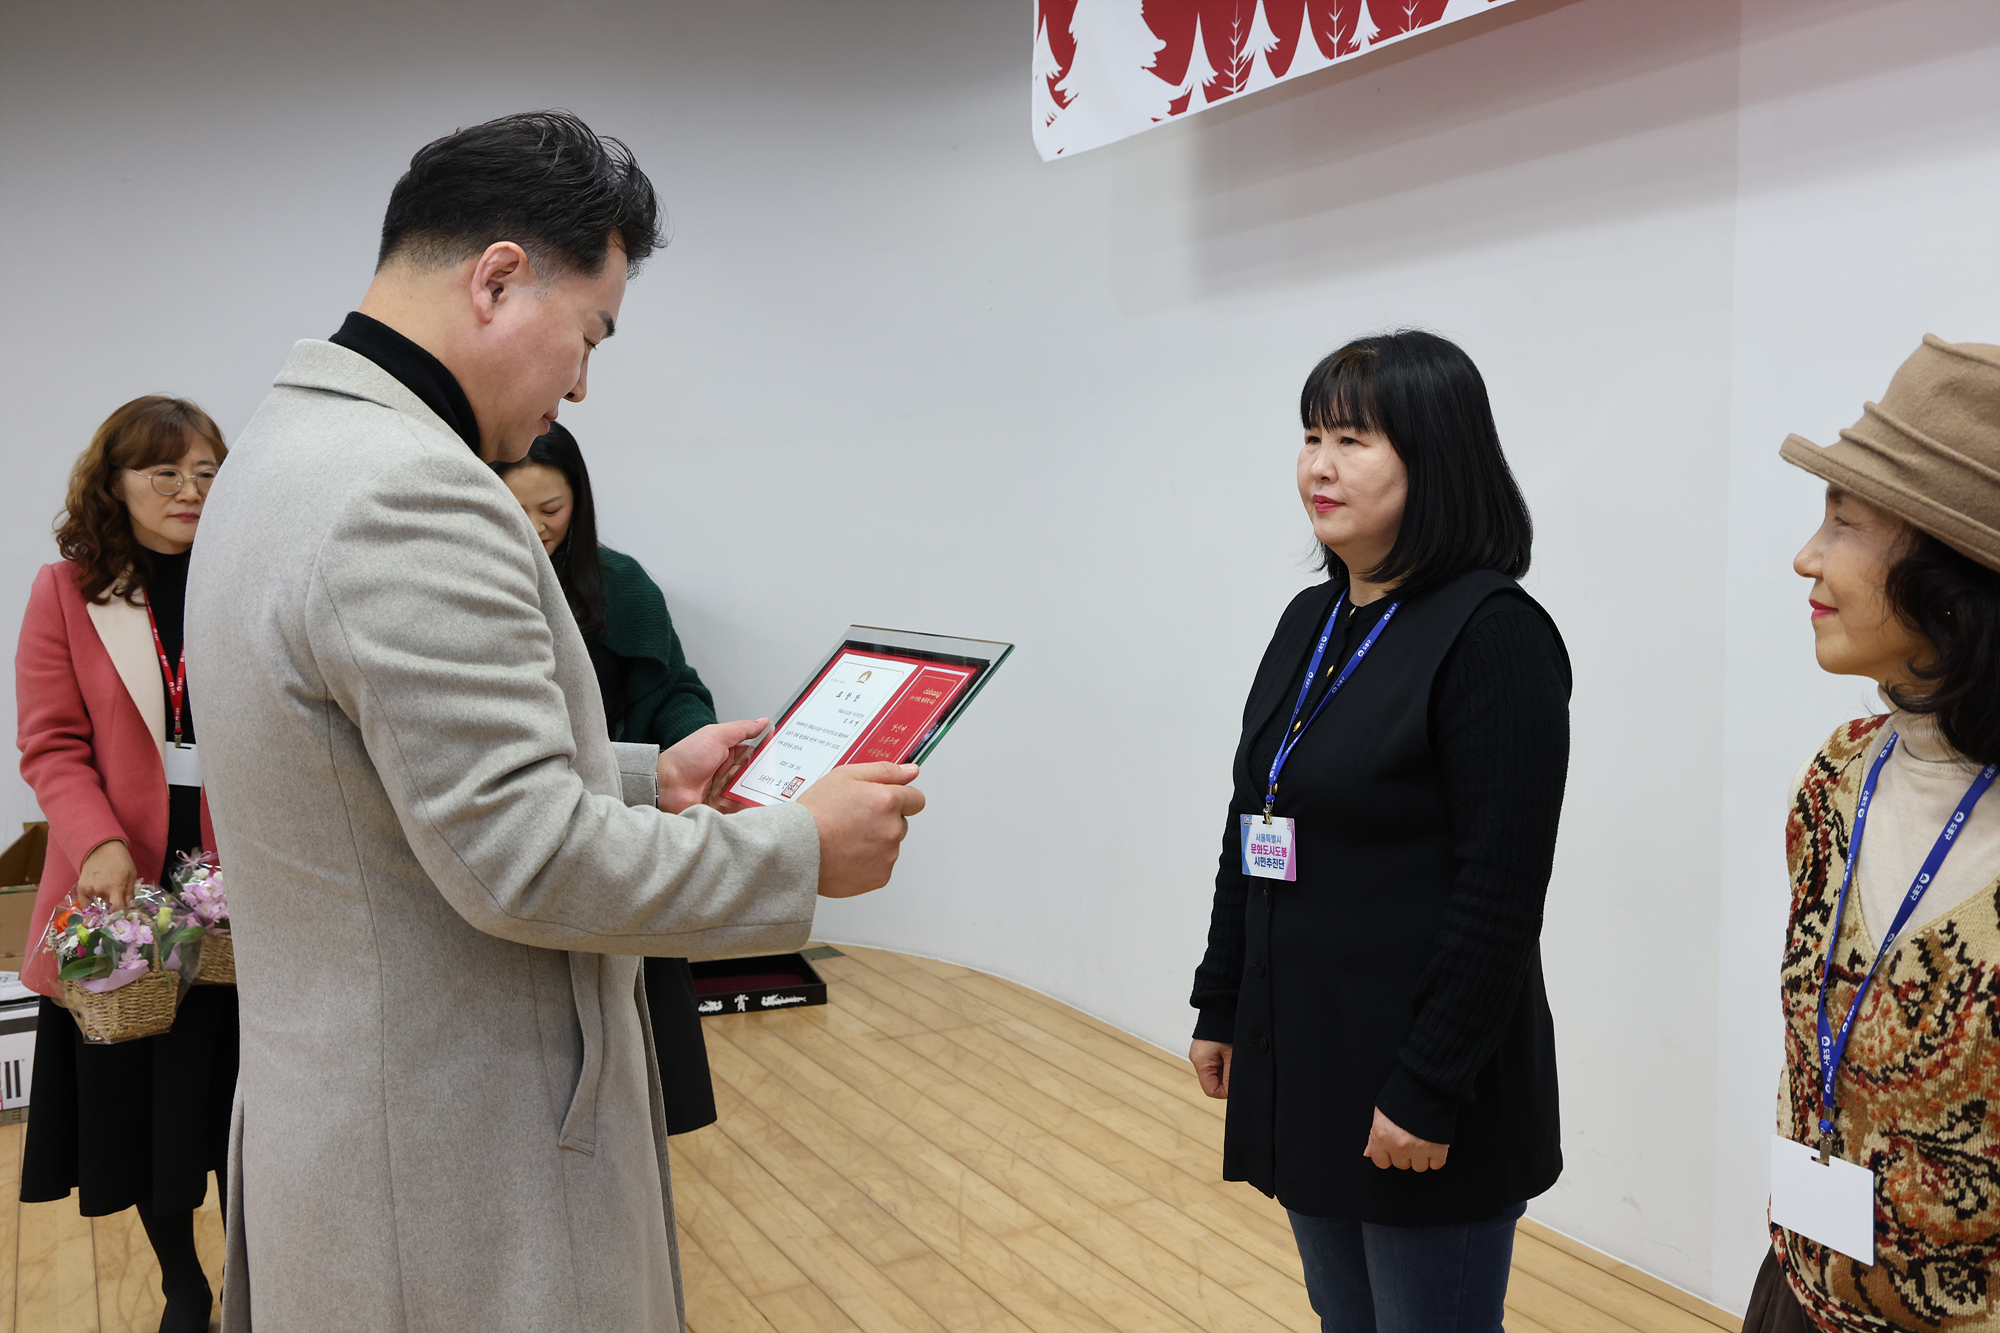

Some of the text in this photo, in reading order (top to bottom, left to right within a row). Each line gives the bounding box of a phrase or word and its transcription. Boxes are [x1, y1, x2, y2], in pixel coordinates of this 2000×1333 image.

[1363, 640, 1372, 651] 도봉구
[1861, 790, 1869, 807] 도봉구
[1256, 833, 1282, 844] 서울특별시
[1944, 822, 1958, 840] 도봉구
[1251, 844, 1287, 857] 문화도시도봉
[1254, 856, 1285, 870] 시민추진단
[1910, 883, 1923, 901] 도봉구
[1823, 1048, 1831, 1066] 도봉구
